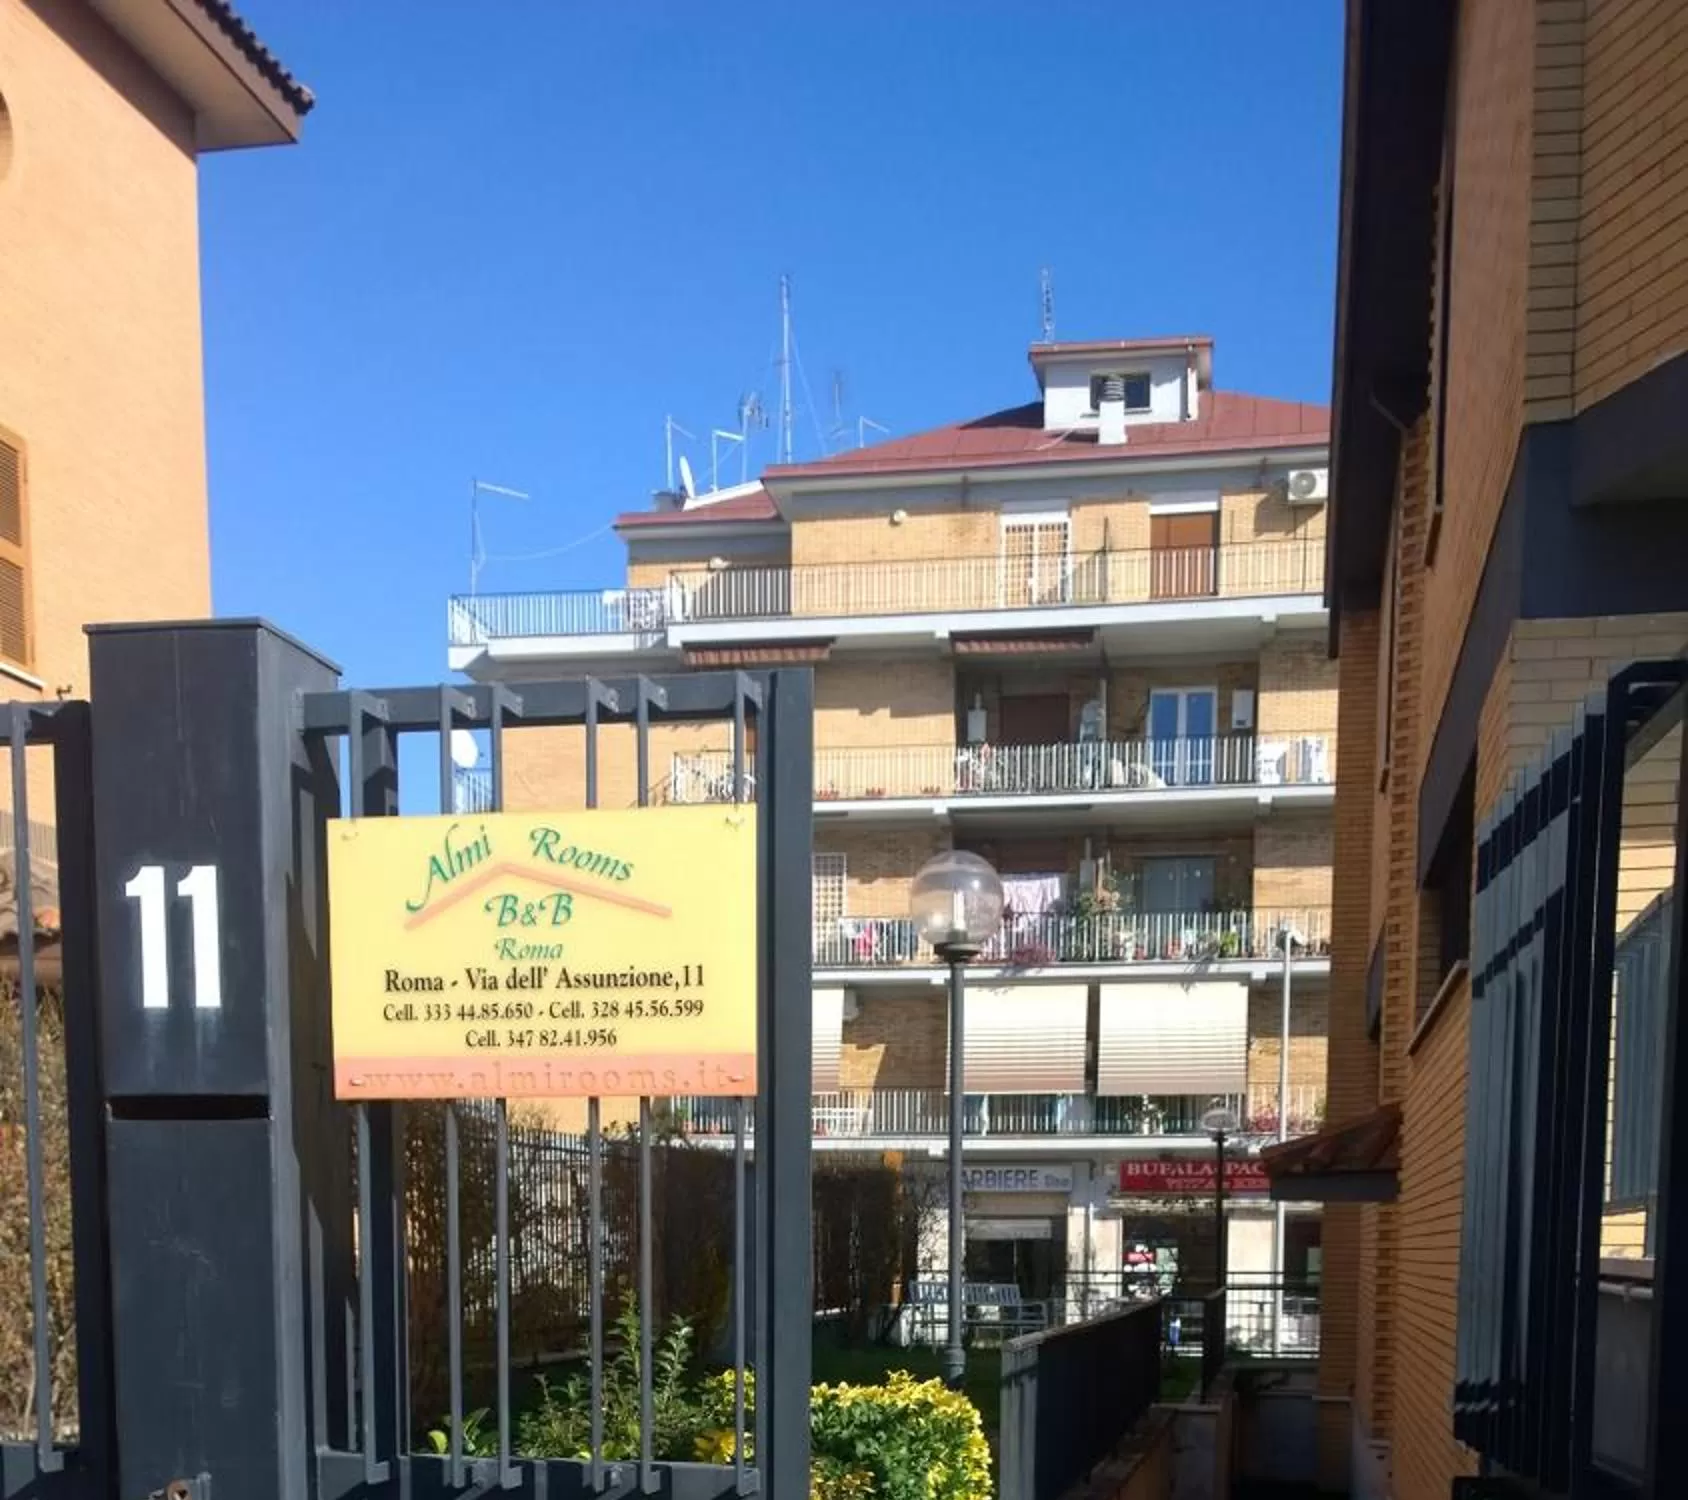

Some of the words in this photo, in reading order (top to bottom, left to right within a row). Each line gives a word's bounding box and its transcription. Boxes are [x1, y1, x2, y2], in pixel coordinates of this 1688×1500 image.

[406, 823, 492, 912] Almi
[529, 827, 634, 881] Rooms
[484, 892, 574, 928] B&B
[125, 865, 222, 1009] 11
[494, 937, 563, 961] Roma
[384, 969, 444, 992] Roma
[465, 967, 498, 990] Via
[505, 965, 548, 990] dell'
[383, 1003, 418, 1021] Cell.
[424, 1003, 451, 1021] 333
[457, 1002, 533, 1021] 44.85.650
[549, 1000, 585, 1019] Cell.
[592, 1001, 619, 1018] 328
[625, 999, 704, 1018] 45.56.599
[465, 1029, 501, 1047] Cell.
[508, 1029, 533, 1048] 347
[539, 1029, 617, 1047] 82.41.956
[363, 1061, 728, 1092] www.almirooms.it
[949, 1168, 1040, 1190] ARBIERE
